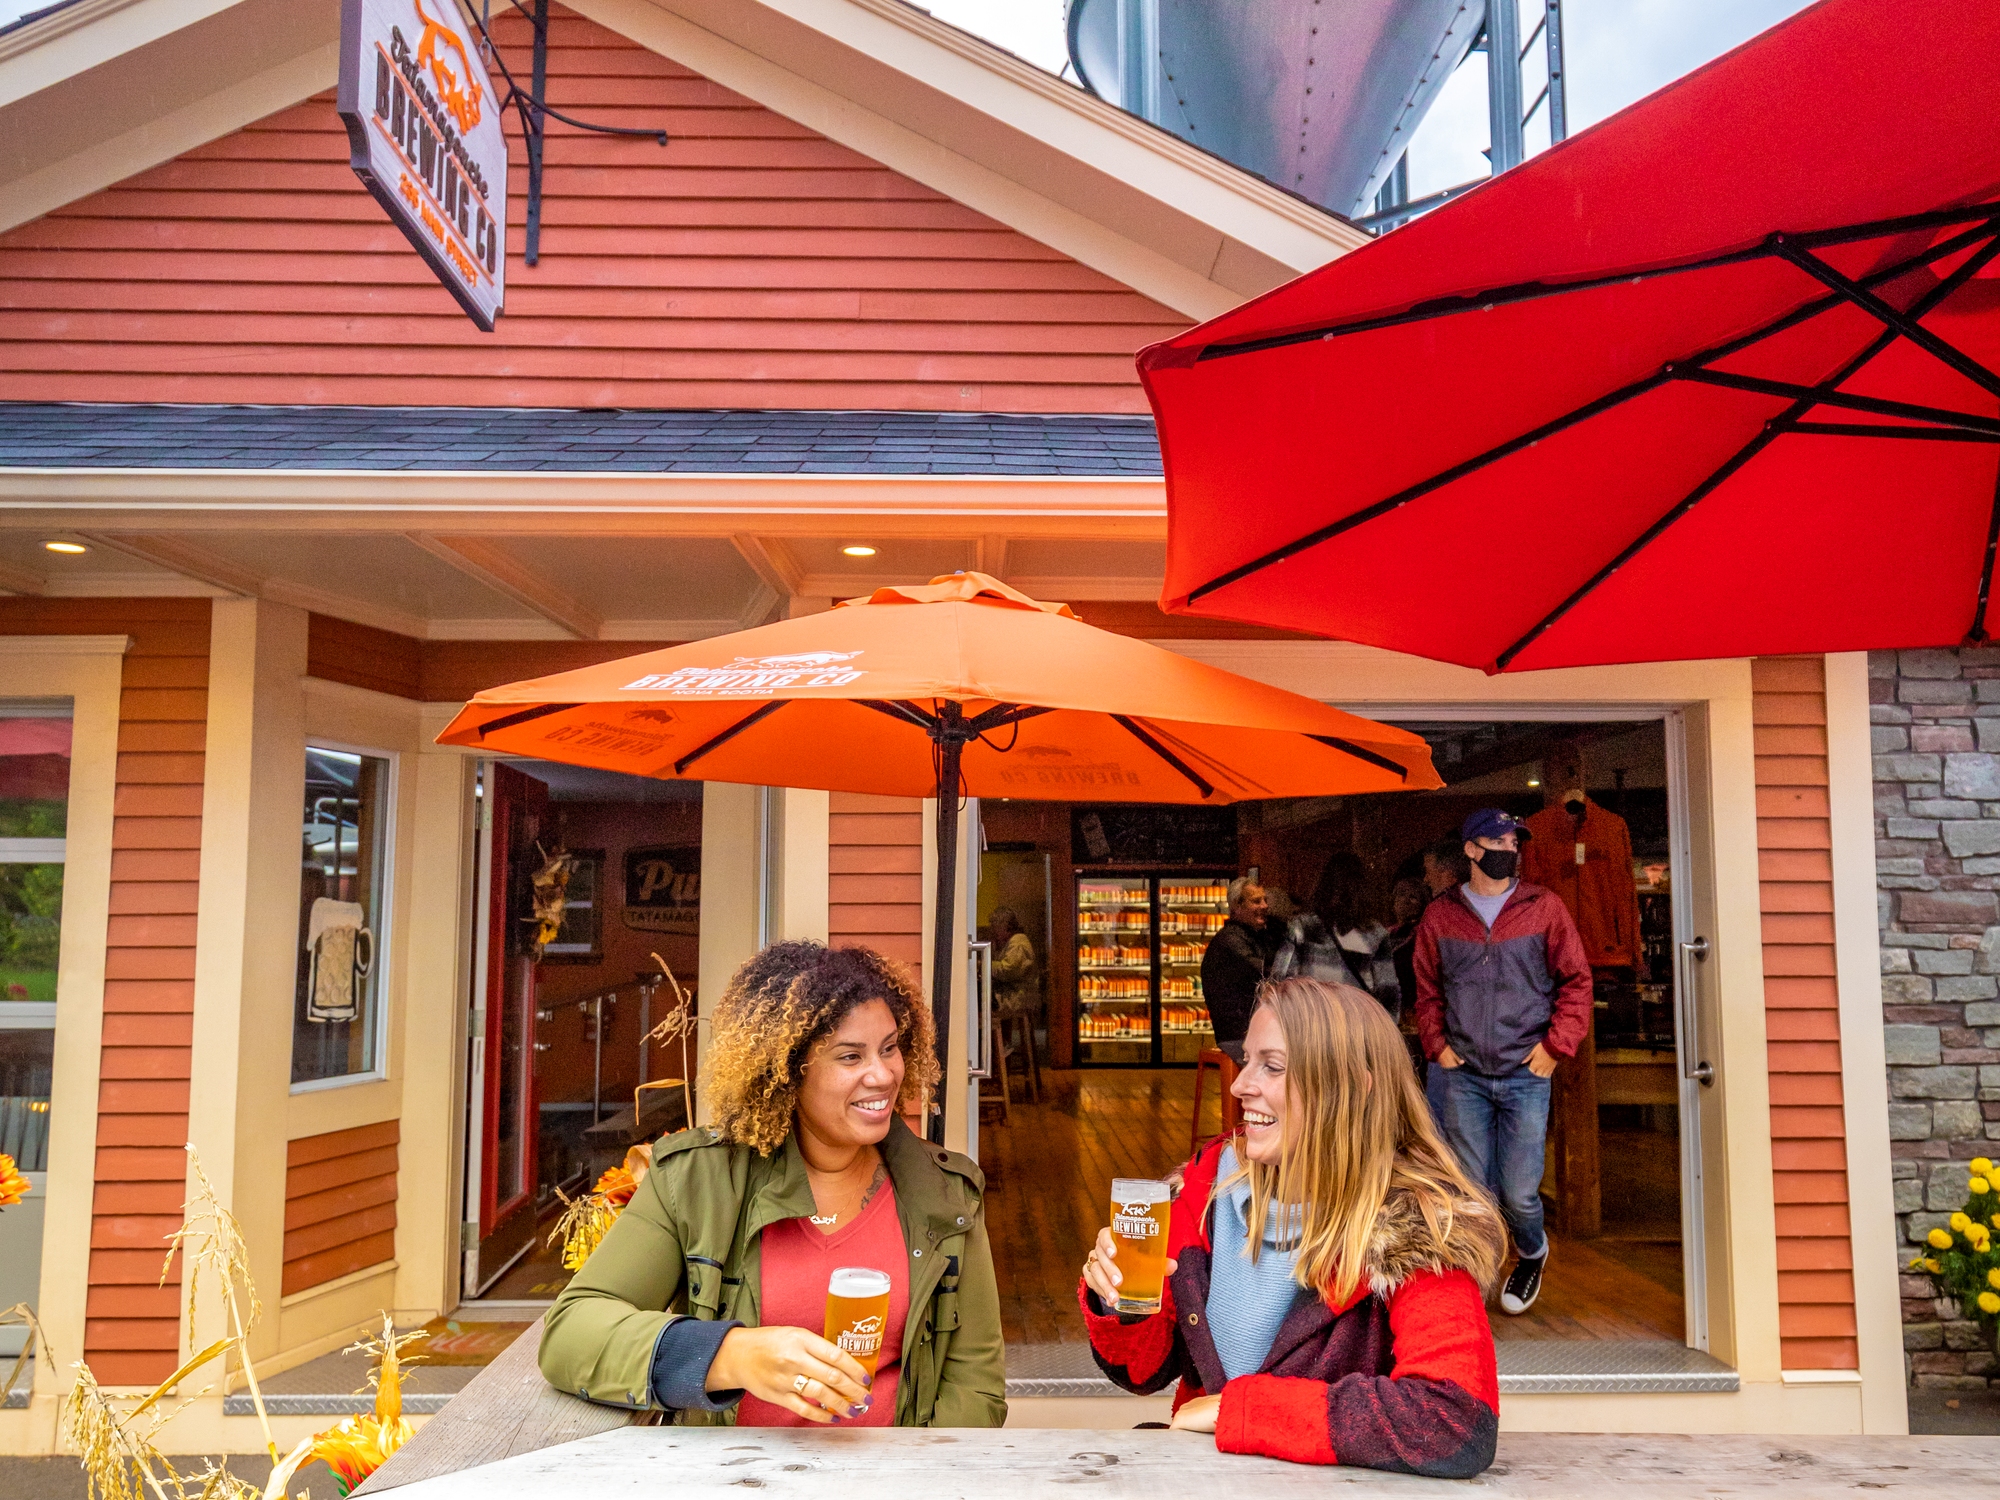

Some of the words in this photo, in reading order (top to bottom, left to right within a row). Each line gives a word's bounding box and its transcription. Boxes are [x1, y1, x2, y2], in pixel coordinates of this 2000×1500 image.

[391, 25, 489, 200] Tatamagouche
[375, 50, 469, 238] BREWING
[475, 206, 497, 274] CO
[446, 236, 478, 288] STREET
[624, 673, 801, 688] BREWING
[806, 672, 863, 685] CO
[635, 859, 701, 903] Pu
[1149, 1223, 1159, 1234] CO
[837, 1337, 875, 1350] BREWING
